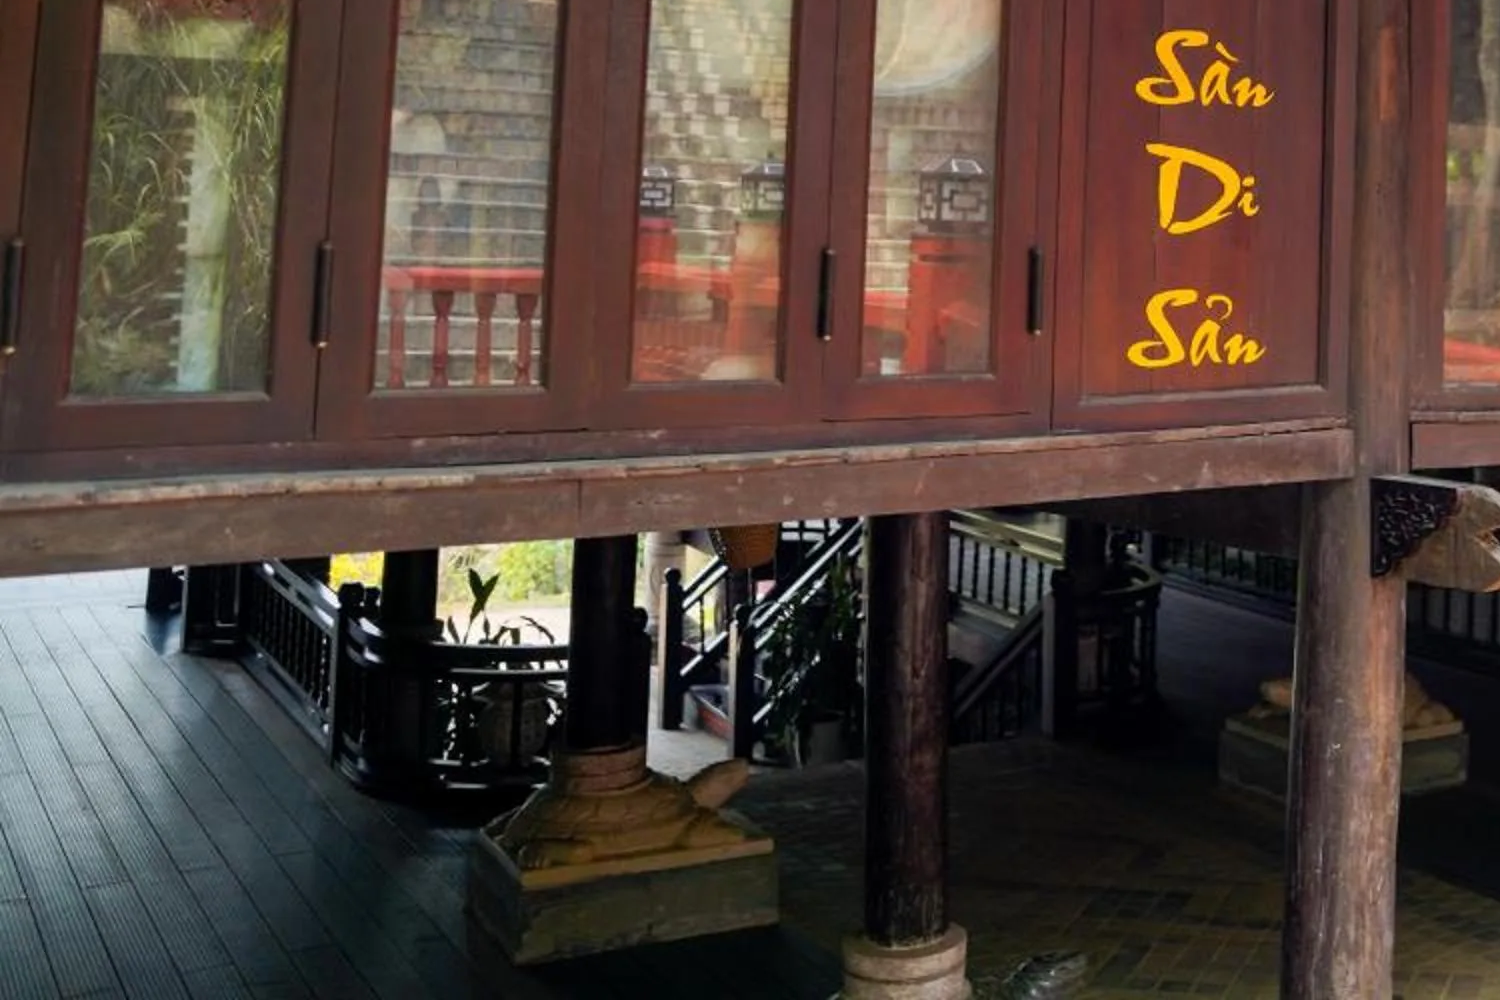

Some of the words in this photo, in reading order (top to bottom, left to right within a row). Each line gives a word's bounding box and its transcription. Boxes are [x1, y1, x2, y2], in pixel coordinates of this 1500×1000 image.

[1135, 29, 1275, 108] Sàn
[1145, 142, 1260, 237] Di
[1126, 287, 1267, 370] Sản
